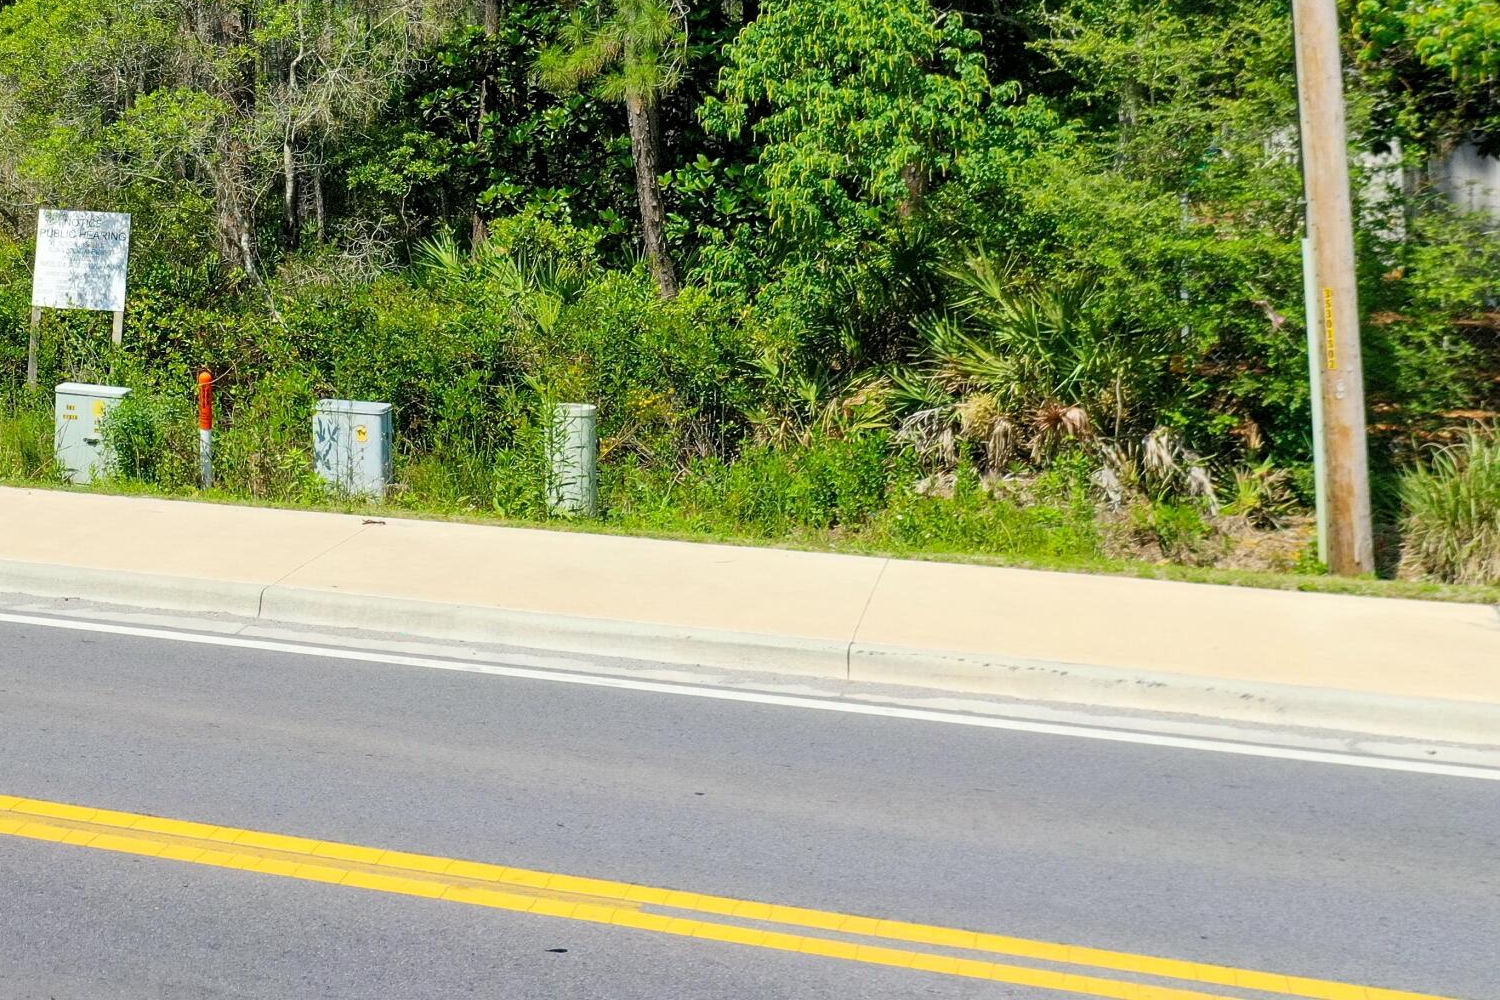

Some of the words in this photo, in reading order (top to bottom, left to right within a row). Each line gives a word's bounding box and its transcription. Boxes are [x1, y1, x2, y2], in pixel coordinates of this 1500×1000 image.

[64, 218, 102, 228] NOTICE
[39, 228, 77, 239] PUBLIC
[79, 230, 127, 242] HEARING
